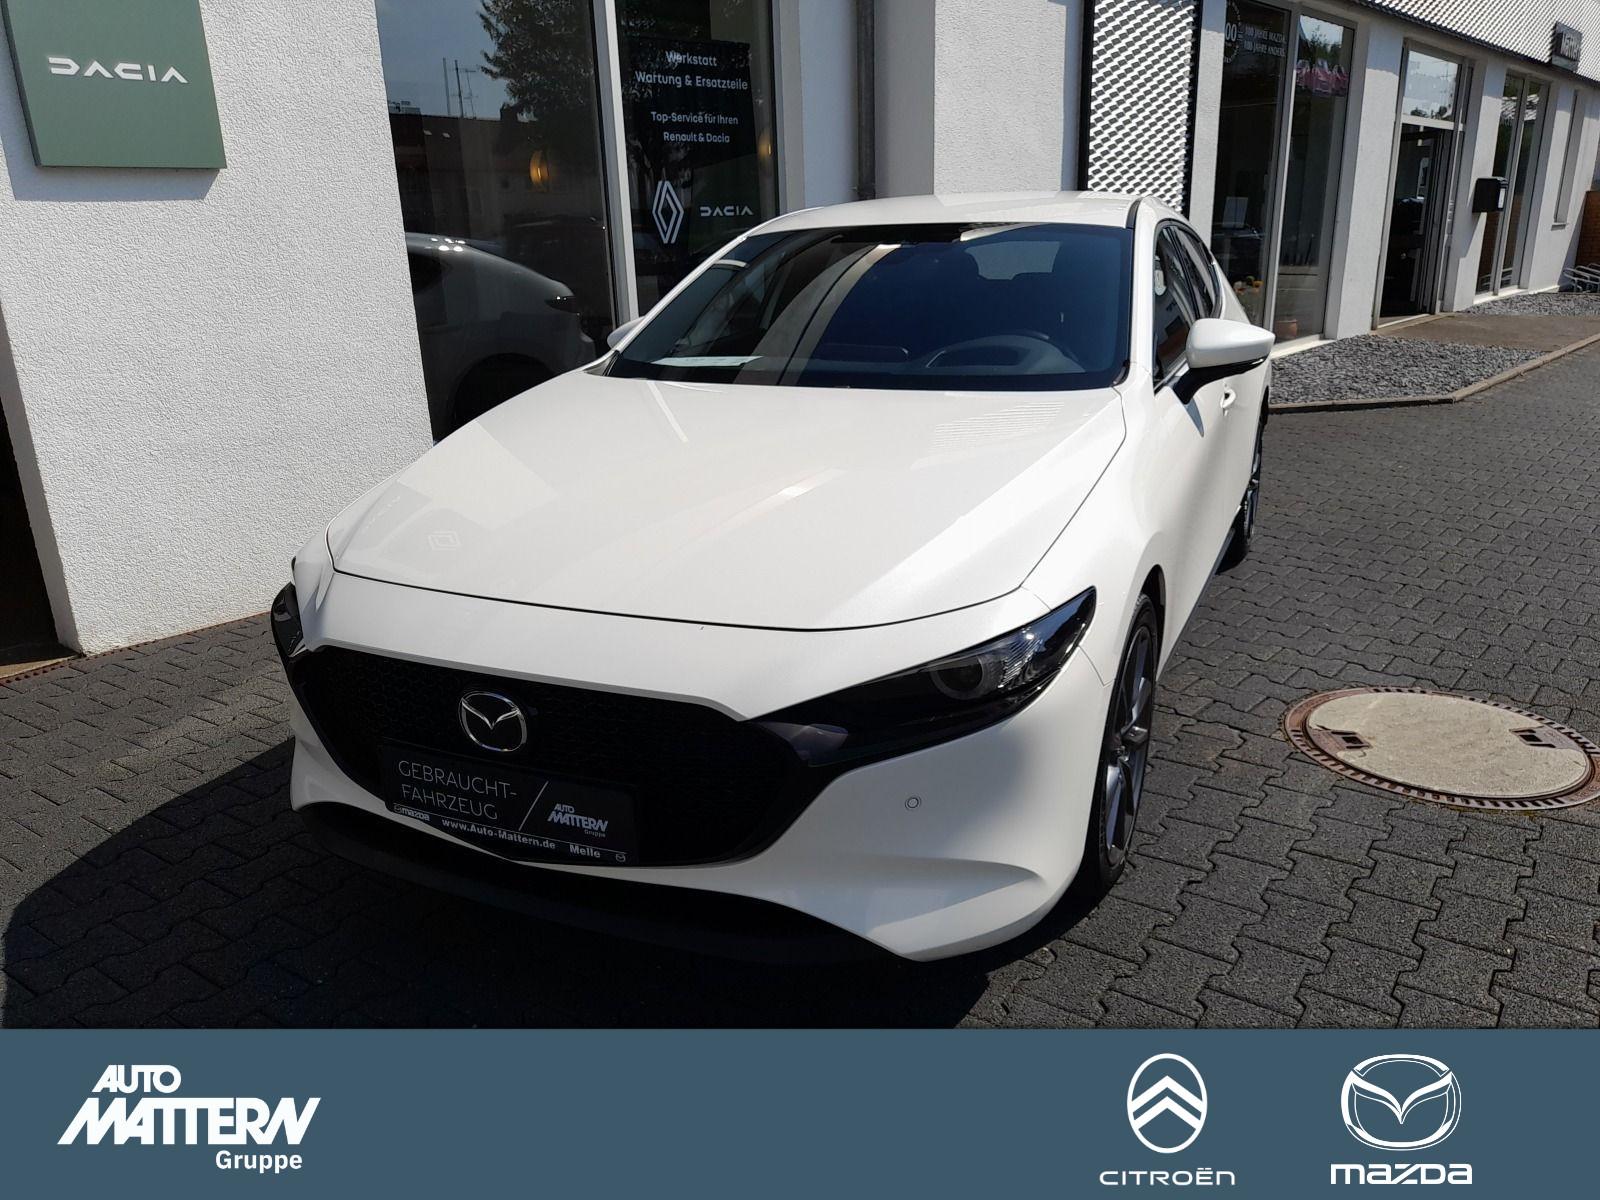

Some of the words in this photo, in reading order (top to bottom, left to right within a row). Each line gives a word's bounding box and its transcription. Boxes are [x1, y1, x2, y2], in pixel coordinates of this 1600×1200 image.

[665, 50, 717, 66] Werkstatt
[48, 57, 188, 84] DACIA
[635, 70, 682, 88] Wartung
[684, 75, 692, 86] &
[695, 75, 748, 90] Ersatzteile
[650, 111, 703, 123] Top-Service
[704, 113, 717, 123] für
[717, 114, 739, 125] Ihren
[663, 131, 697, 142] Renault
[698, 133, 705, 142] &
[706, 132, 730, 143] Dacia
[700, 205, 754, 217] DACIA
[398, 760, 517, 799] GEBRAUCHT-
[402, 783, 498, 820] FAHRZEUG
[554, 803, 575, 813] AUTO
[547, 810, 608, 832] MATTERN
[441, 818, 556, 850] www.Auto-Mattern.de
[569, 843, 601, 859] Melle
[584, 829, 606, 838] Gruppe
